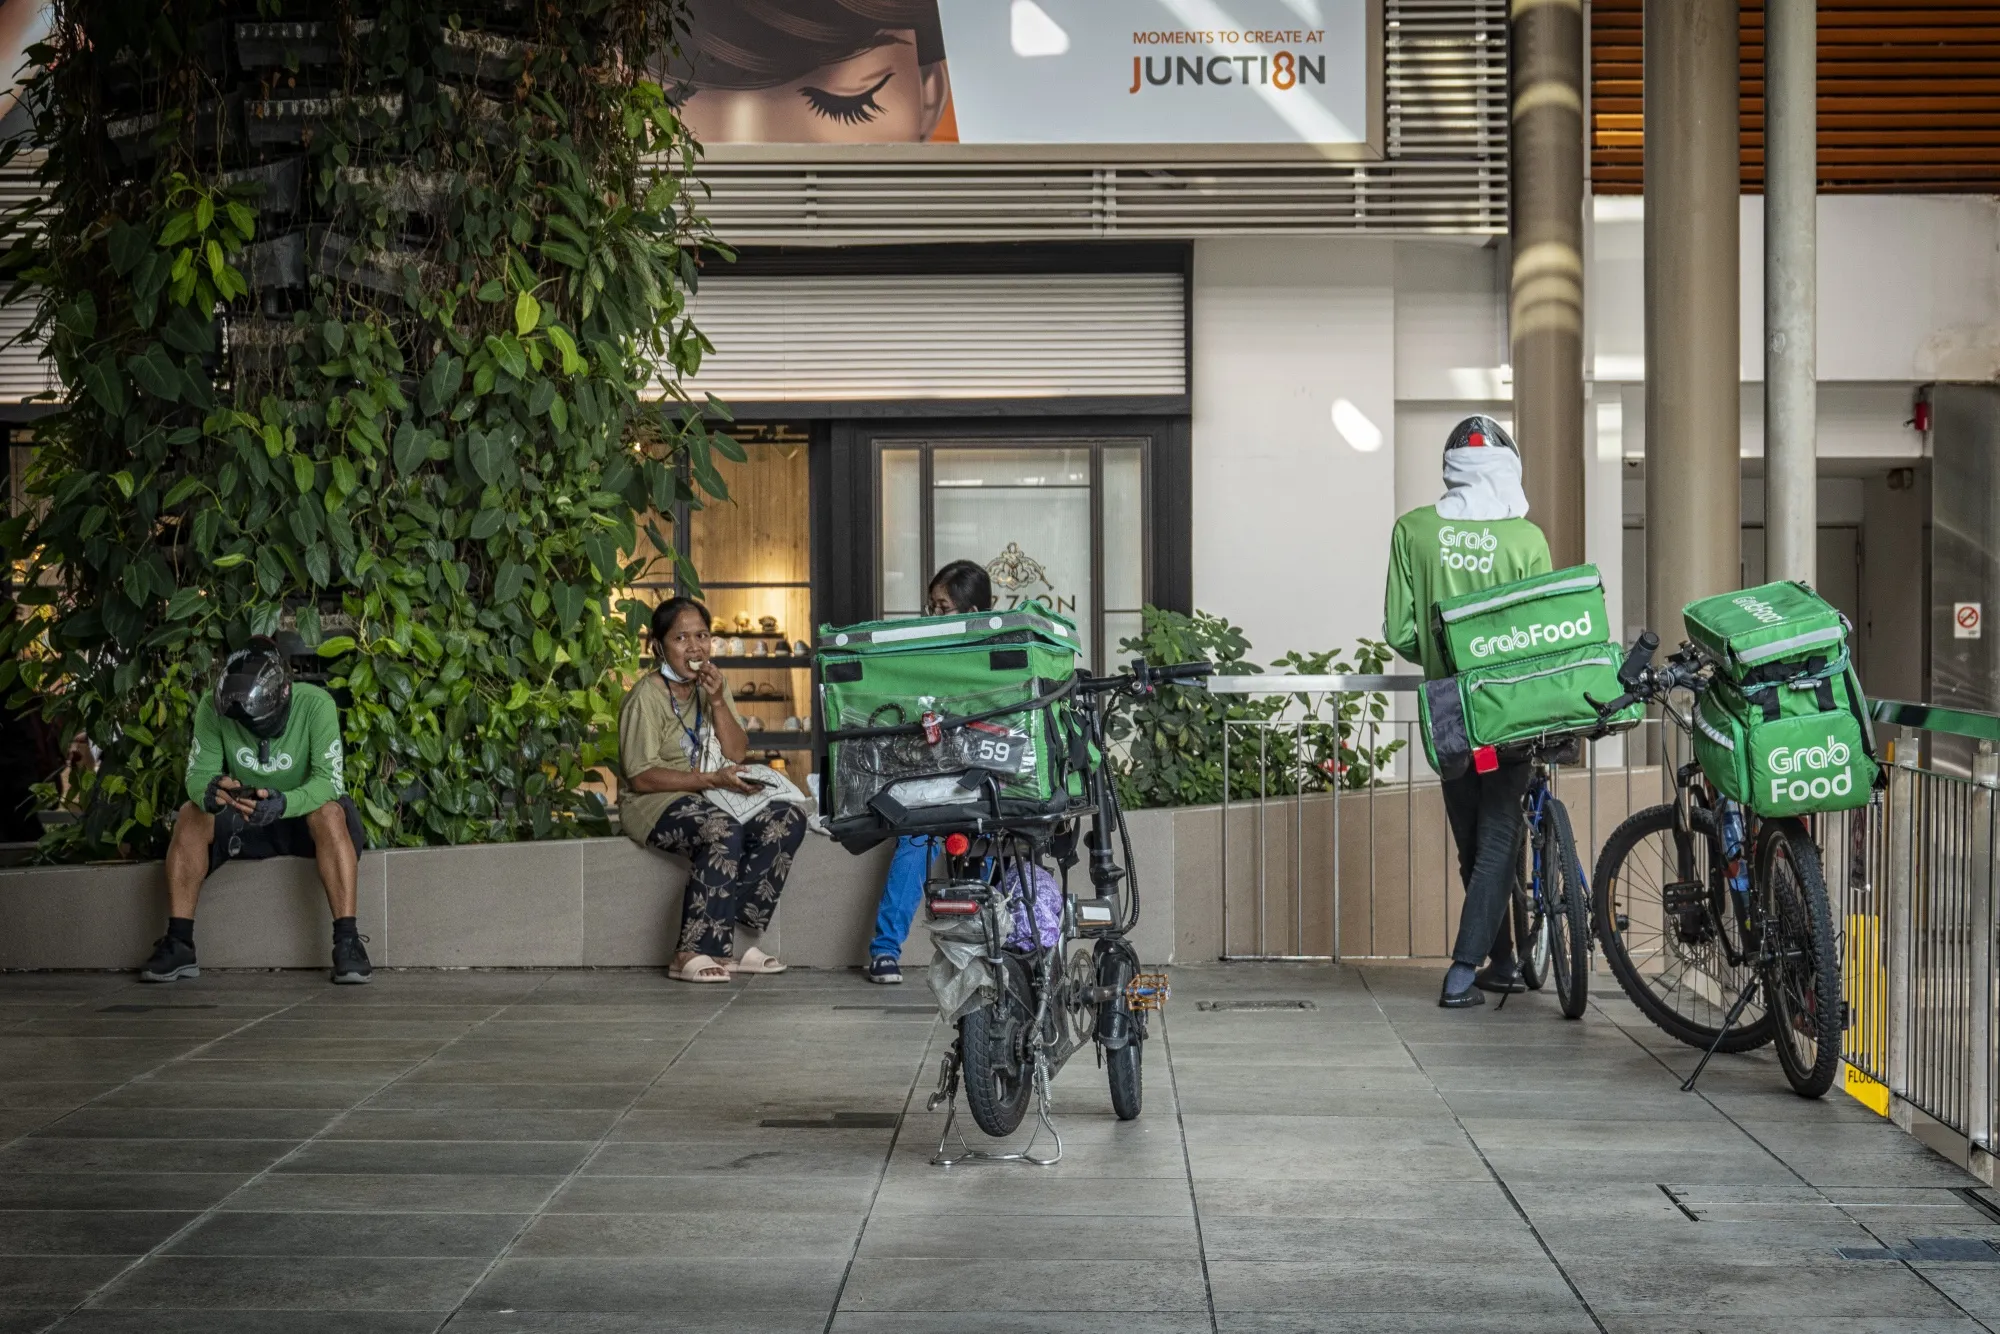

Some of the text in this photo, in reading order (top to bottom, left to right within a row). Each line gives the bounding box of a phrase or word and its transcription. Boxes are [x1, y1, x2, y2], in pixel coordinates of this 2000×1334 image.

[1133, 30, 1325, 45] MOMENTS TO CREATE AT
[1438, 525, 1498, 552] Grab
[1440, 547, 1494, 574] Food
[1469, 610, 1592, 658] GrabFood
[979, 739, 1010, 762] 59
[1768, 735, 1850, 775] Grab
[1770, 765, 1852, 804] Food
[1848, 1070, 1879, 1084] FLOO
